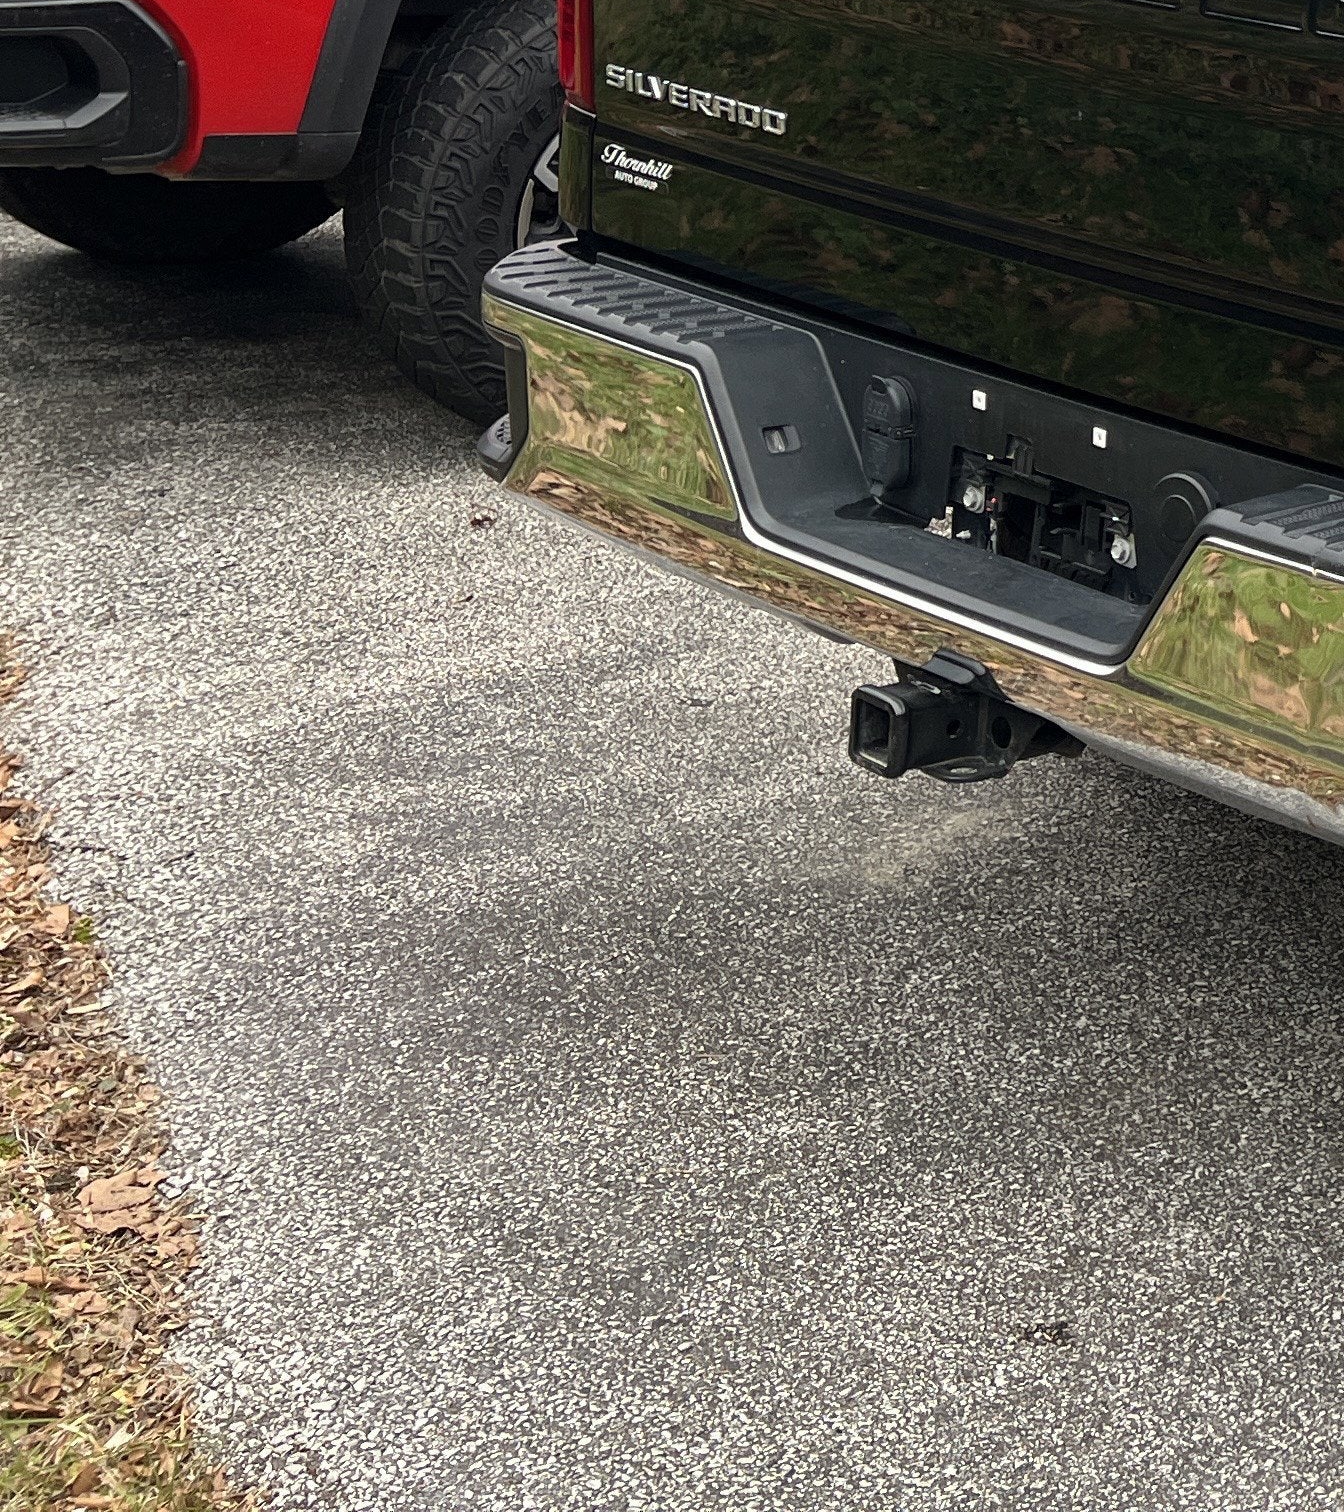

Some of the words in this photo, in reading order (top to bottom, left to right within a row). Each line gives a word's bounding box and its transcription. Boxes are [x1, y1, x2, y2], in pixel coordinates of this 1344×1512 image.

[605, 63, 789, 136] SILVERADO
[600, 143, 674, 180] Thornhill
[614, 169, 634, 184] AUTO
[633, 175, 659, 191] GROUP
